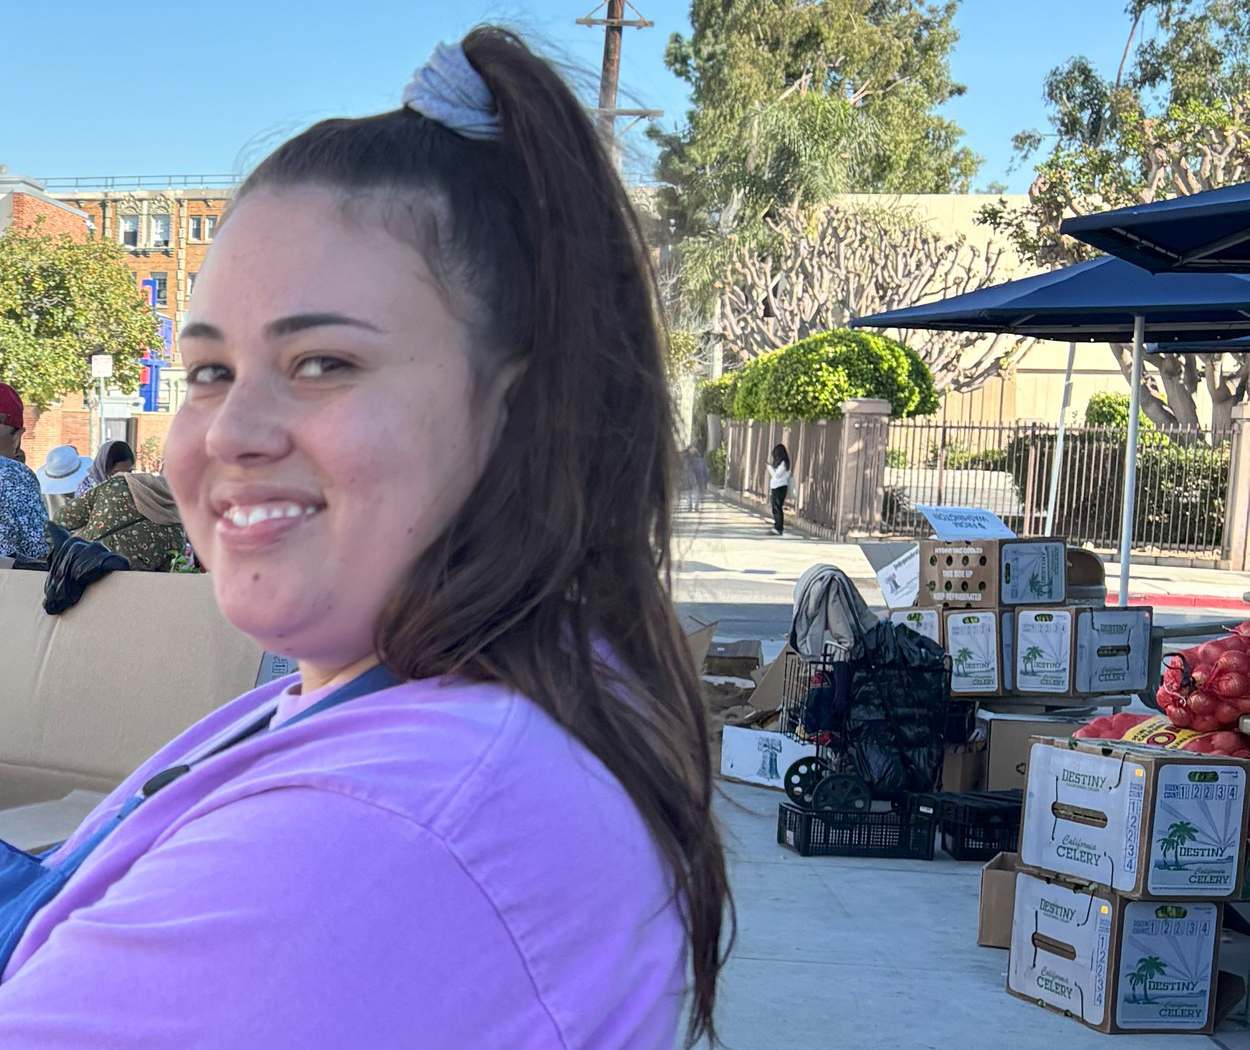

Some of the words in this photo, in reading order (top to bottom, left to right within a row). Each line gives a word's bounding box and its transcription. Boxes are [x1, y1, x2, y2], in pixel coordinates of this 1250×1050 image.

[965, 569, 973, 578] UP
[1100, 624, 1128, 634] DESTINY
[1034, 661, 1062, 669] DESTINY
[1098, 672, 1126, 682] CELERY
[1062, 768, 1107, 788] DESTINY
[1194, 786, 1200, 798] 2
[1218, 787, 1223, 799] 3
[1230, 786, 1235, 798] 4
[1130, 815, 1137, 828] 2
[1062, 834, 1097, 850] California
[1056, 845, 1102, 867] CELERY
[1127, 845, 1135, 857] 3
[1179, 847, 1226, 857] DESTINY
[1126, 859, 1134, 871] 4
[1194, 867, 1226, 876] California
[1189, 875, 1229, 885] CELERY
[1039, 898, 1077, 921] DESTINY
[1164, 922, 1170, 934] 2
[1189, 922, 1195, 934] 3
[1201, 922, 1207, 934] 4
[1100, 950, 1106, 963] 2
[1041, 966, 1070, 985] California
[1036, 975, 1073, 1000] CELERY
[1097, 978, 1104, 991] 3
[1148, 980, 1199, 991] DESTINY
[1096, 993, 1102, 1005] 4
[1159, 1008, 1203, 1018] CELERY
